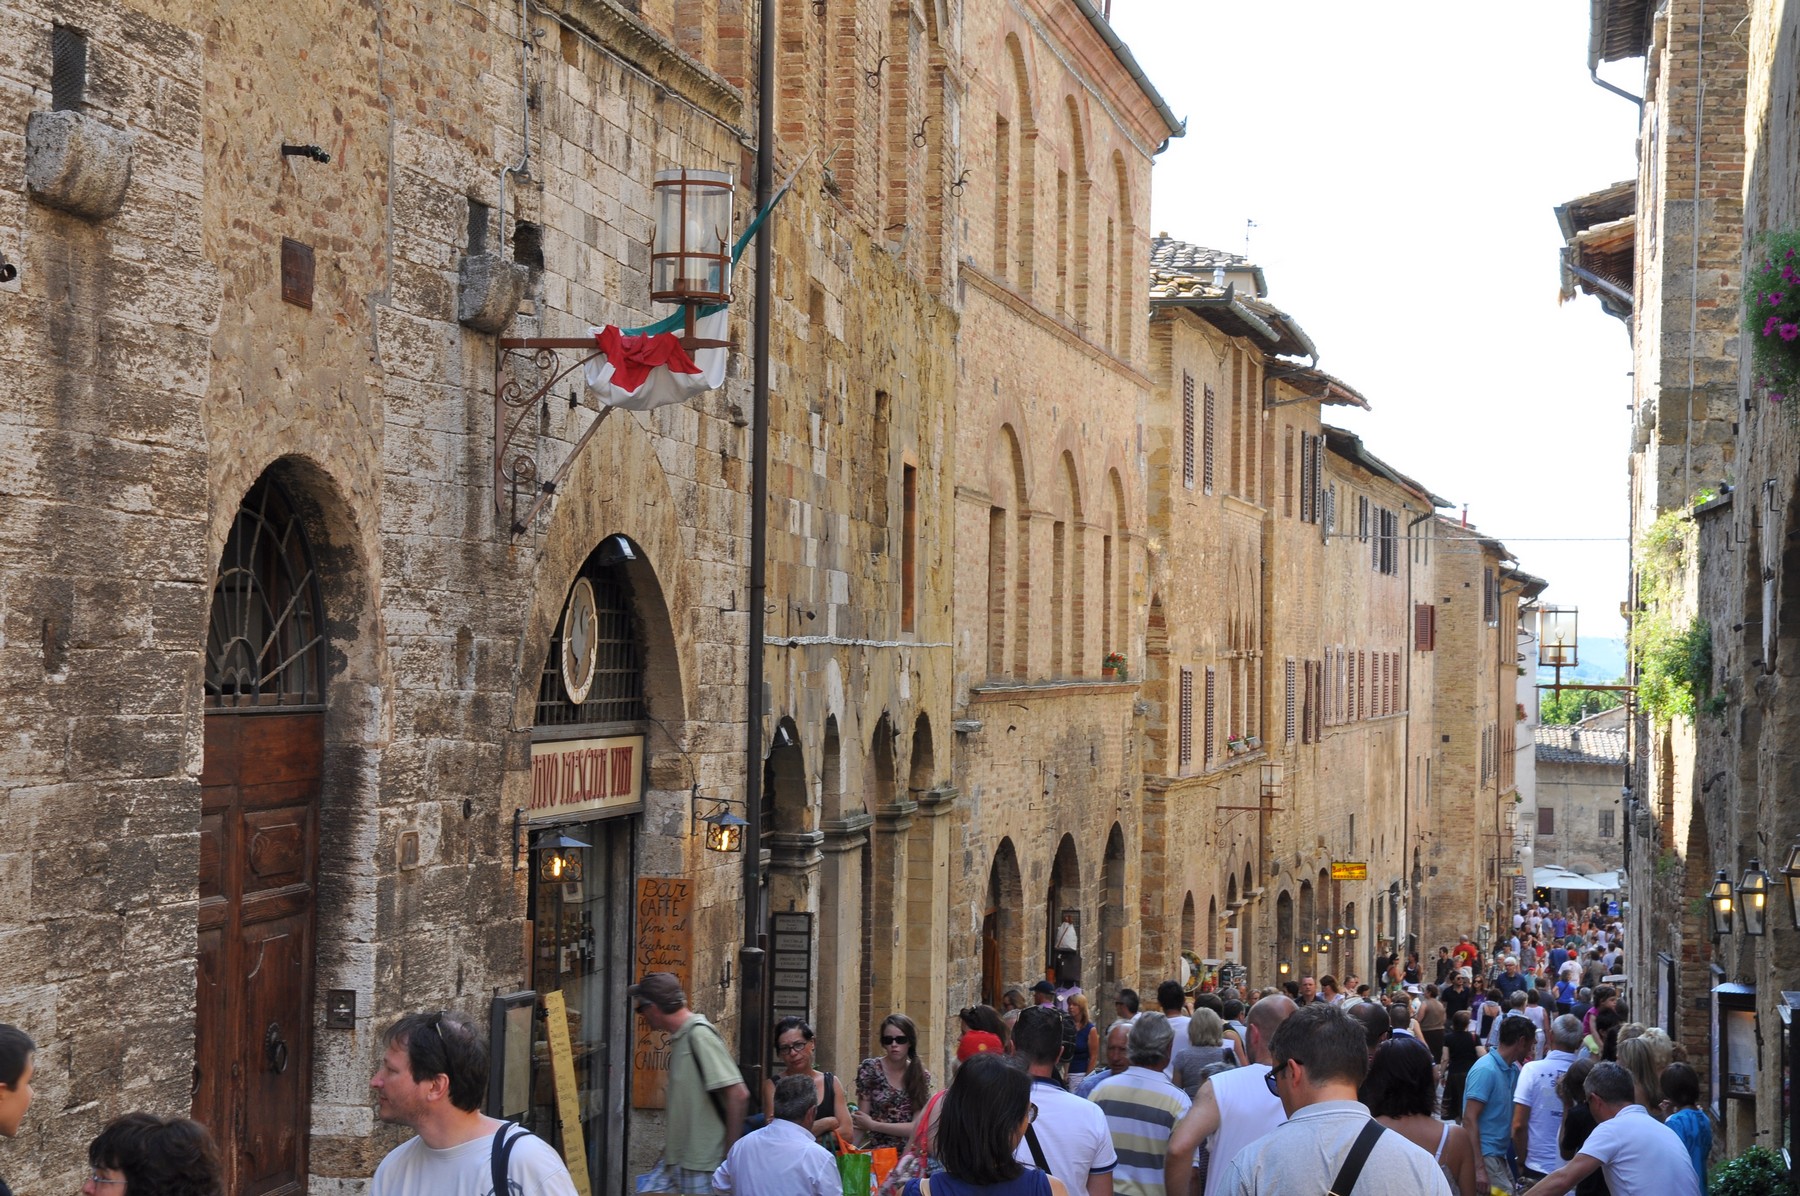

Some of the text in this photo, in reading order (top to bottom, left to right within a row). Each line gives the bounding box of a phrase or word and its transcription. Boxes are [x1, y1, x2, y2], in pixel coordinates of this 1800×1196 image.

[611, 746, 633, 797] VINI
[642, 879, 689, 898] Bar
[640, 917, 687, 935] Vini al
[638, 950, 687, 967] Salumi
[634, 1050, 673, 1071] CANTUCC
